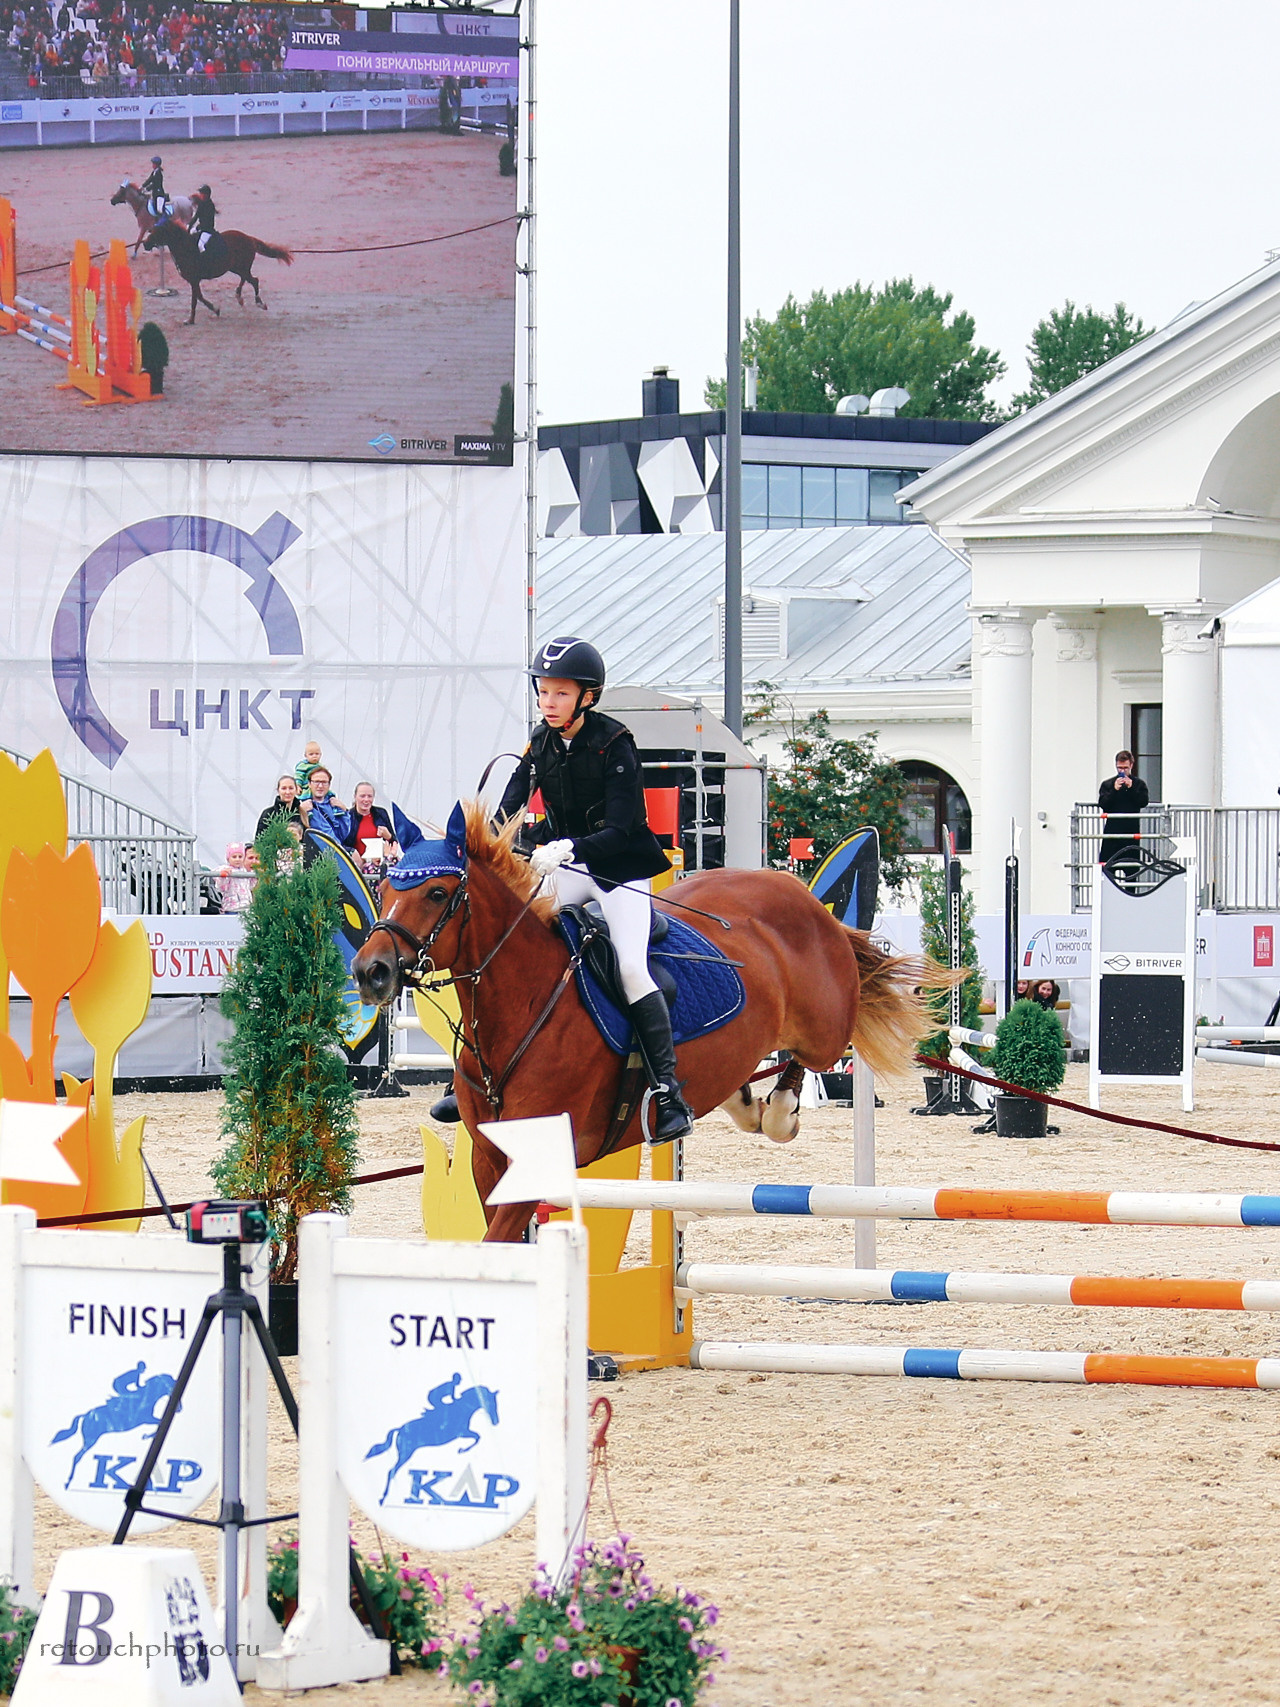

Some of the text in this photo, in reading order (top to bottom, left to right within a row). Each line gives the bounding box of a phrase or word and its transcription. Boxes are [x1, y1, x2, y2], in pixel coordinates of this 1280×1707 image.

[456, 24, 490, 35] ЦНКТ
[337, 55, 510, 74] ПОНИ ЗЕРКАЛЬНЫЙ МАРШРУТ
[114, 105, 140, 113] BITRIVER
[400, 439, 447, 450] BITRIVER
[460, 442, 506, 451] MAXIMA TV
[150, 689, 316, 736] ЦНКТ
[1055, 928, 1087, 939] ФЕДЕРАЦИЯ
[1055, 942, 1080, 951] КОННОГО
[150, 947, 235, 978] USTAN
[1055, 955, 1077, 965] РОССИИ
[1135, 958, 1182, 968] BITRIVER
[69, 1303, 186, 1339] FINISH
[389, 1313, 496, 1350] START
[52, 1589, 114, 1666] B
